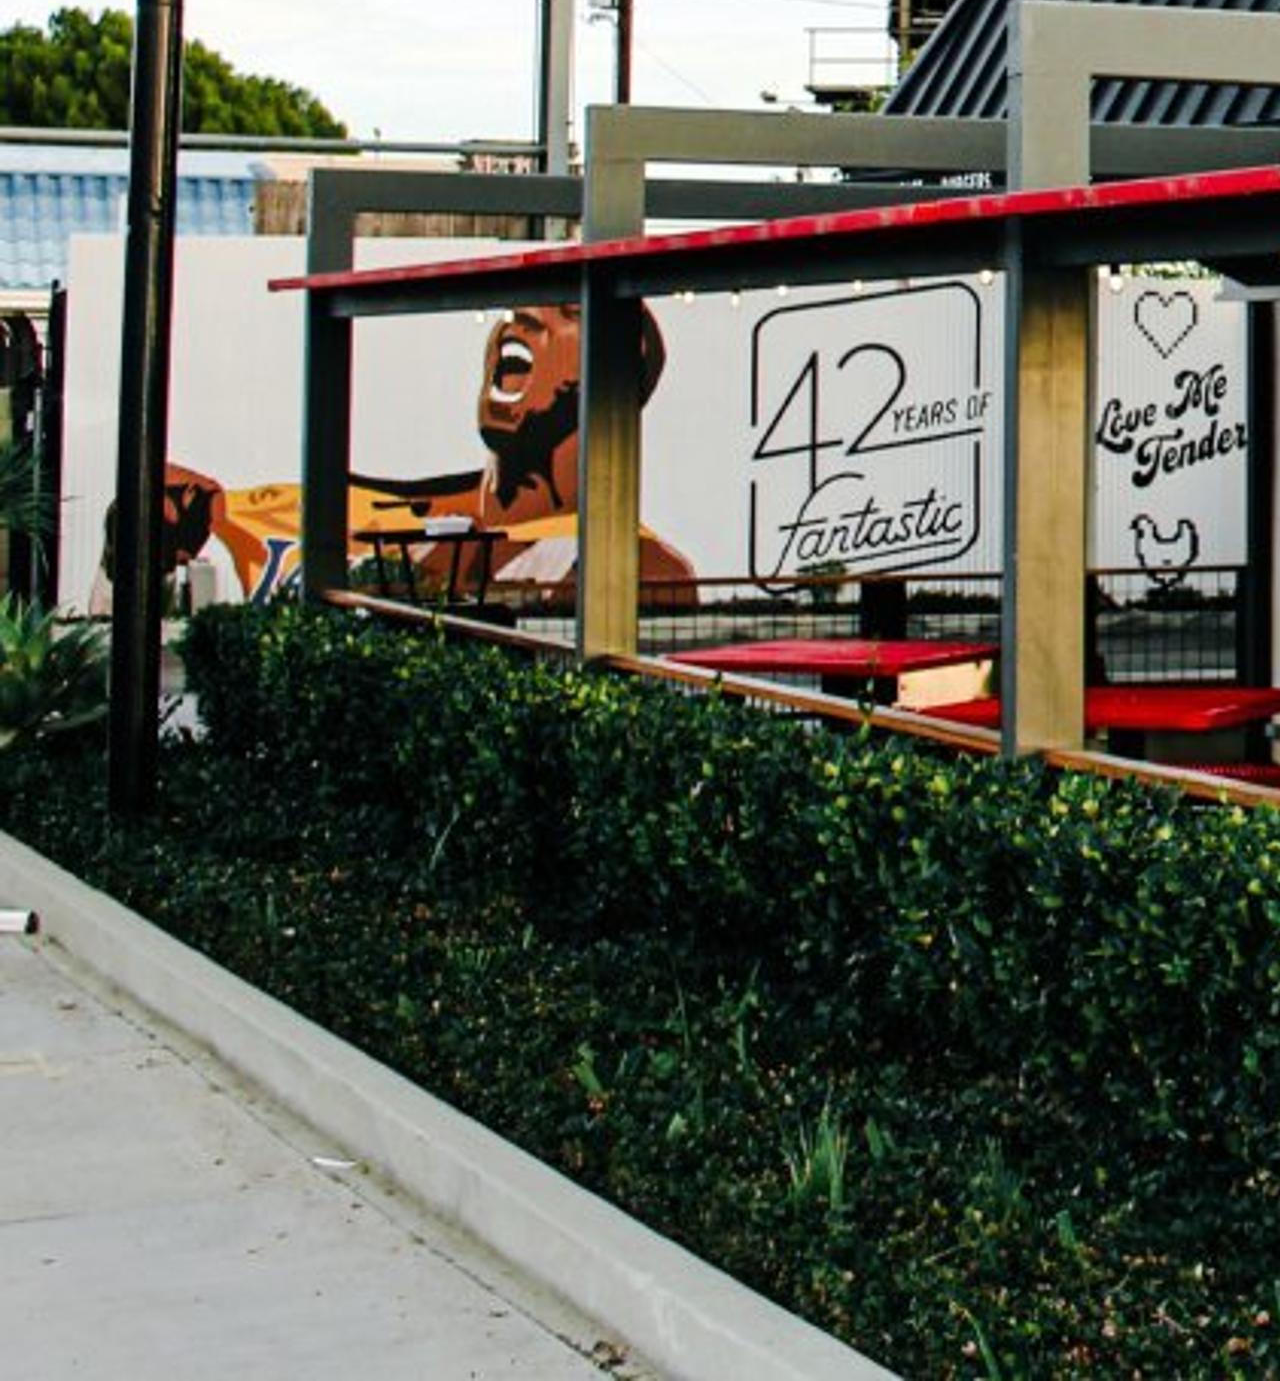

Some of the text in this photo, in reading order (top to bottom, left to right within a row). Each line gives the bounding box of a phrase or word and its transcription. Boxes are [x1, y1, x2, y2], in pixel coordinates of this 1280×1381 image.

[752, 343, 984, 494] 42
[893, 391, 993, 433] YEARS OF
[1096, 362, 1228, 455] Love Me
[1131, 419, 1248, 488] Tender
